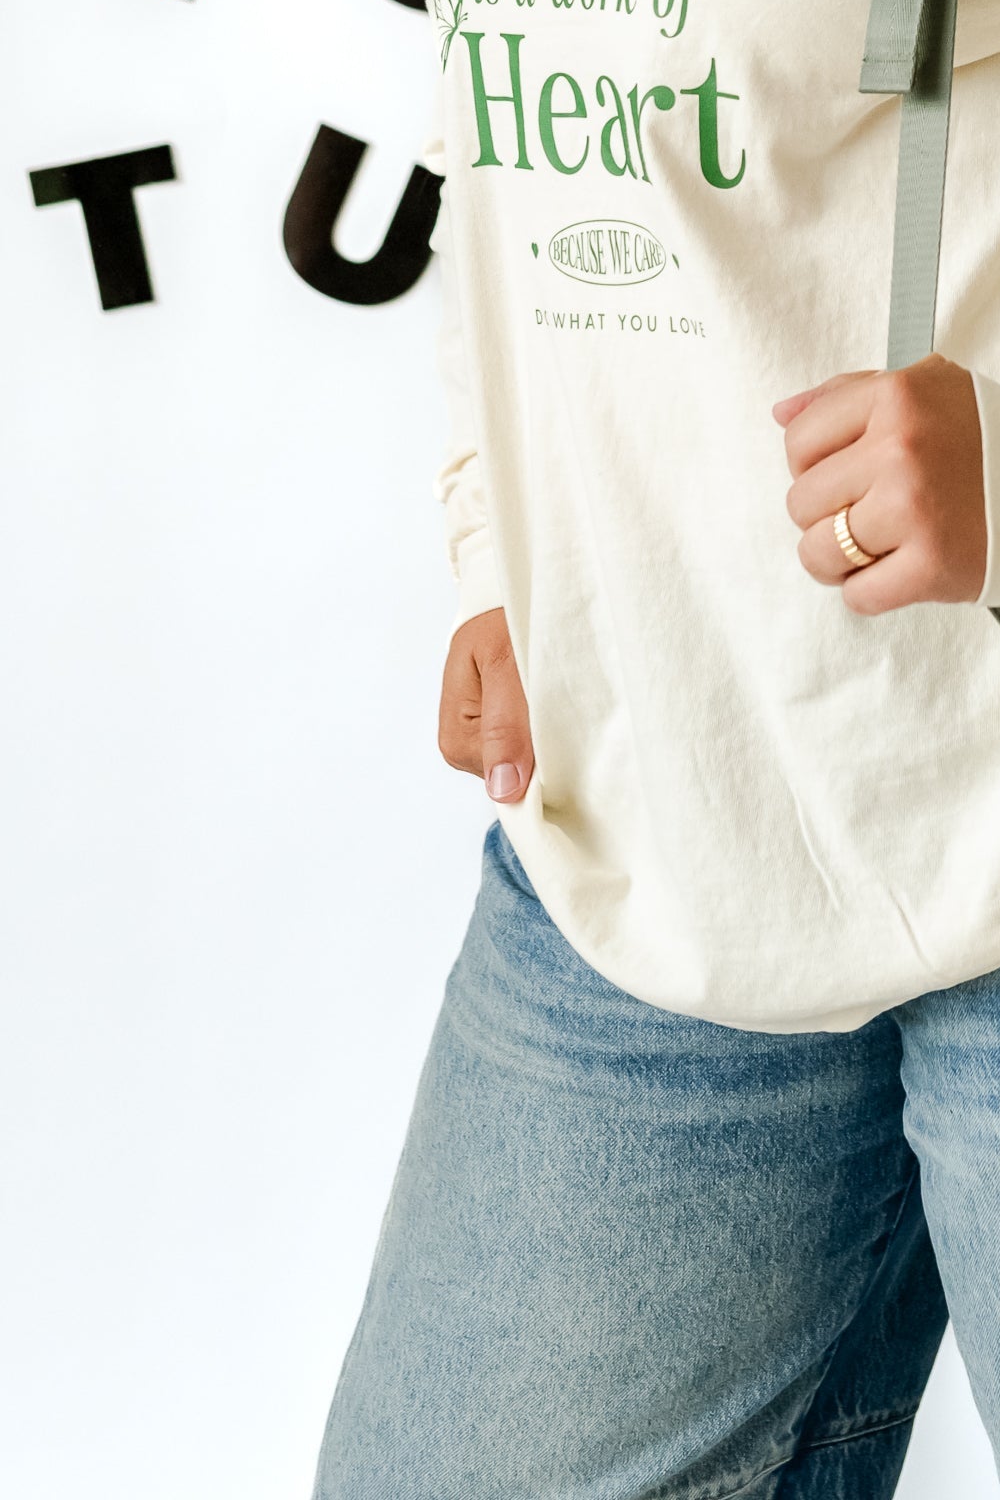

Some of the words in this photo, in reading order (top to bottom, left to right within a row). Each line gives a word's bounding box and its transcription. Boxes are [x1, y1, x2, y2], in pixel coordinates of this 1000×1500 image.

[459, 31, 747, 190] Heart
[29, 144, 177, 311] T
[282, 124, 446, 306] U
[553, 229, 607, 275] BECAUSE
[608, 229, 632, 275] WE
[634, 234, 664, 273] CARE
[552, 312, 606, 331] WHAT
[617, 313, 658, 333] YOU
[669, 316, 707, 339] LOVE
